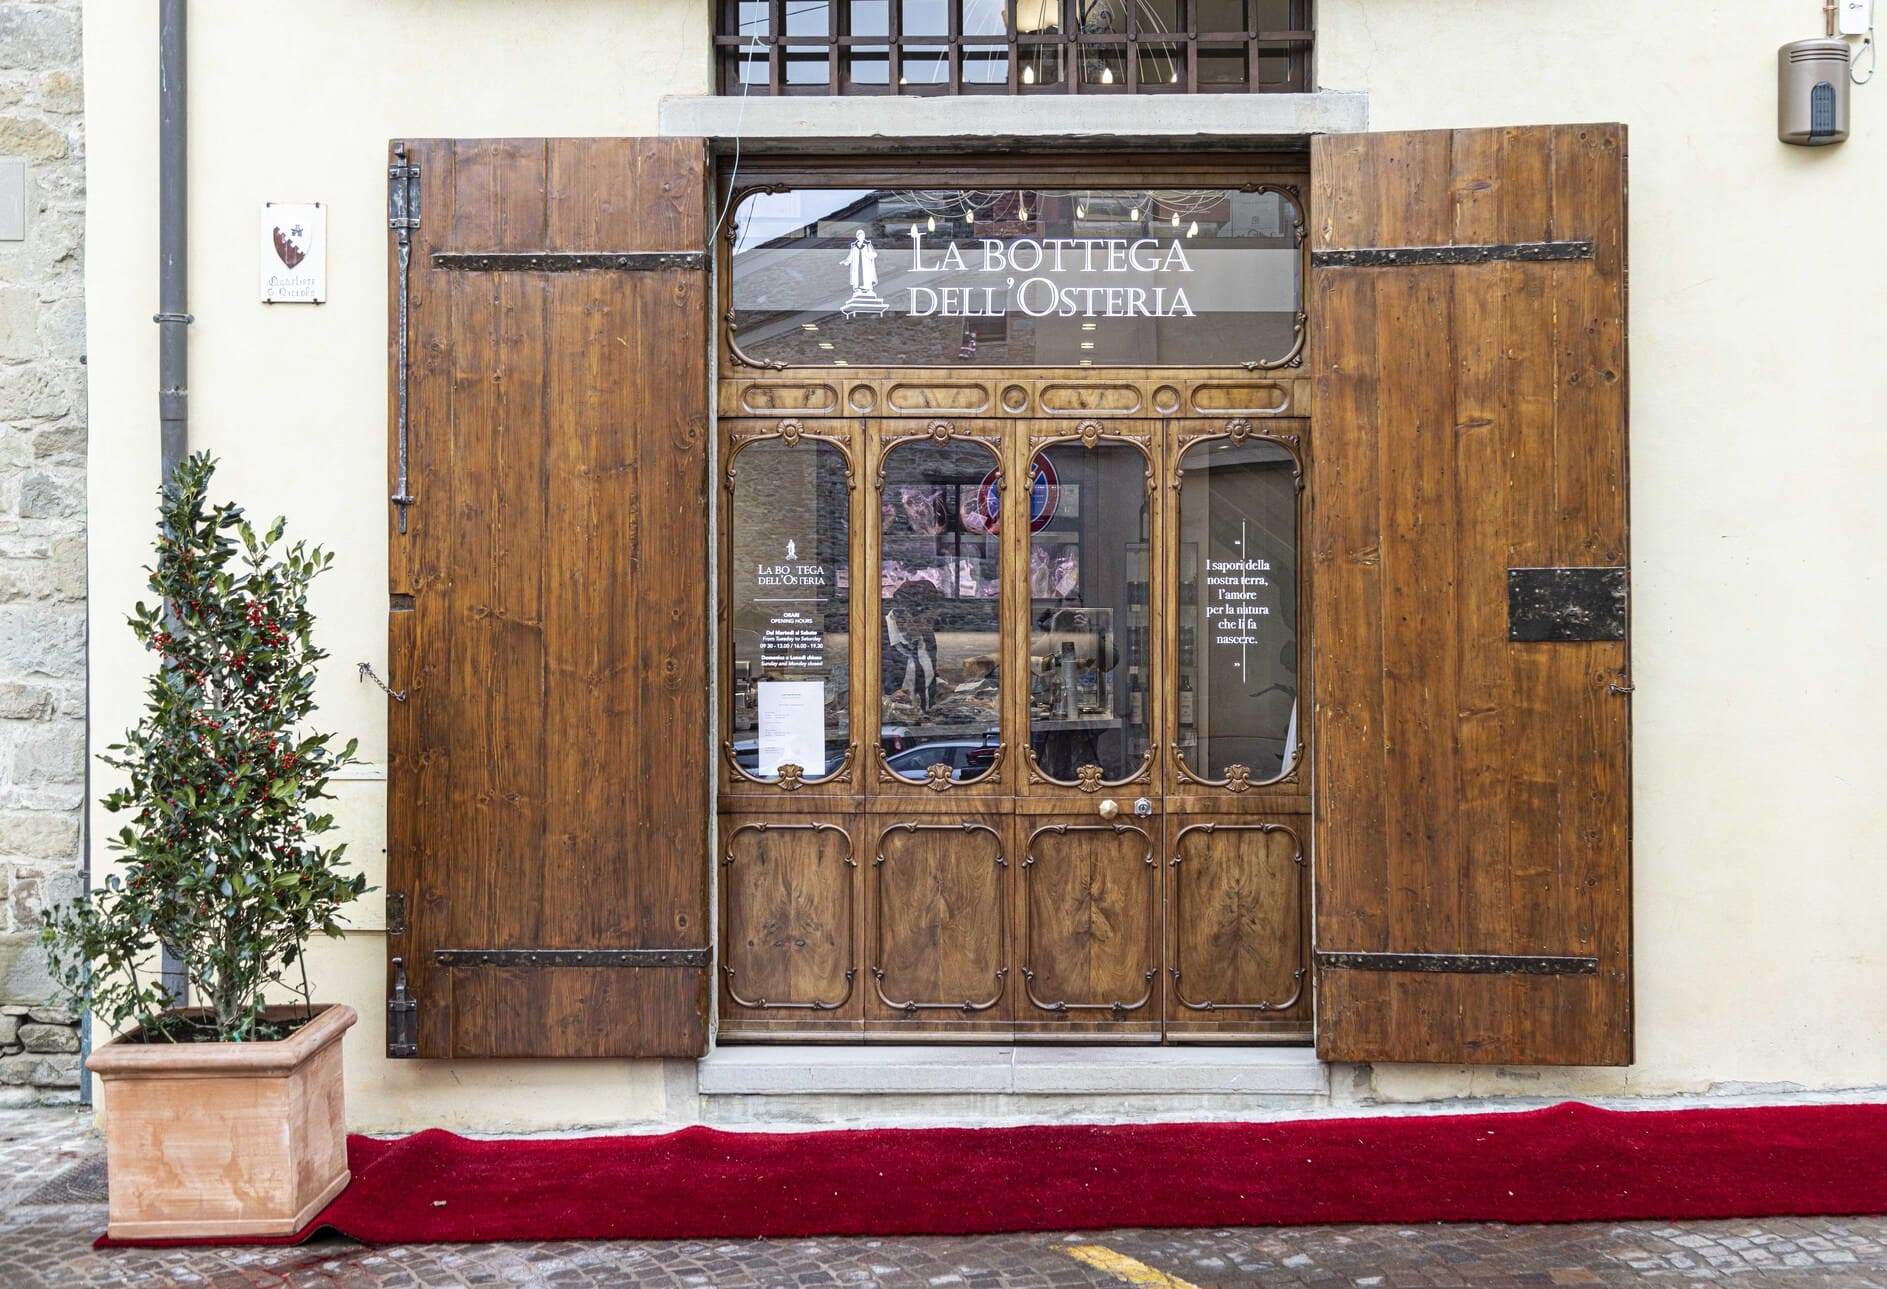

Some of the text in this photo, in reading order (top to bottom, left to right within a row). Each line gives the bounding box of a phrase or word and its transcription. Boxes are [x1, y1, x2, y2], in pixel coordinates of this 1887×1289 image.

[908, 232, 1196, 272] LA BOTTEGA
[906, 277, 1197, 317] DELL'OSTERIA
[758, 564, 825, 575] LA BOTEGA
[1205, 559, 1271, 573] I sapori della
[1207, 576, 1269, 587] nostra terra,
[1218, 588, 1257, 600] l'amore
[1205, 603, 1270, 618] per la natura
[1218, 618, 1258, 629] che li fa
[1216, 636, 1259, 644] nascere.
